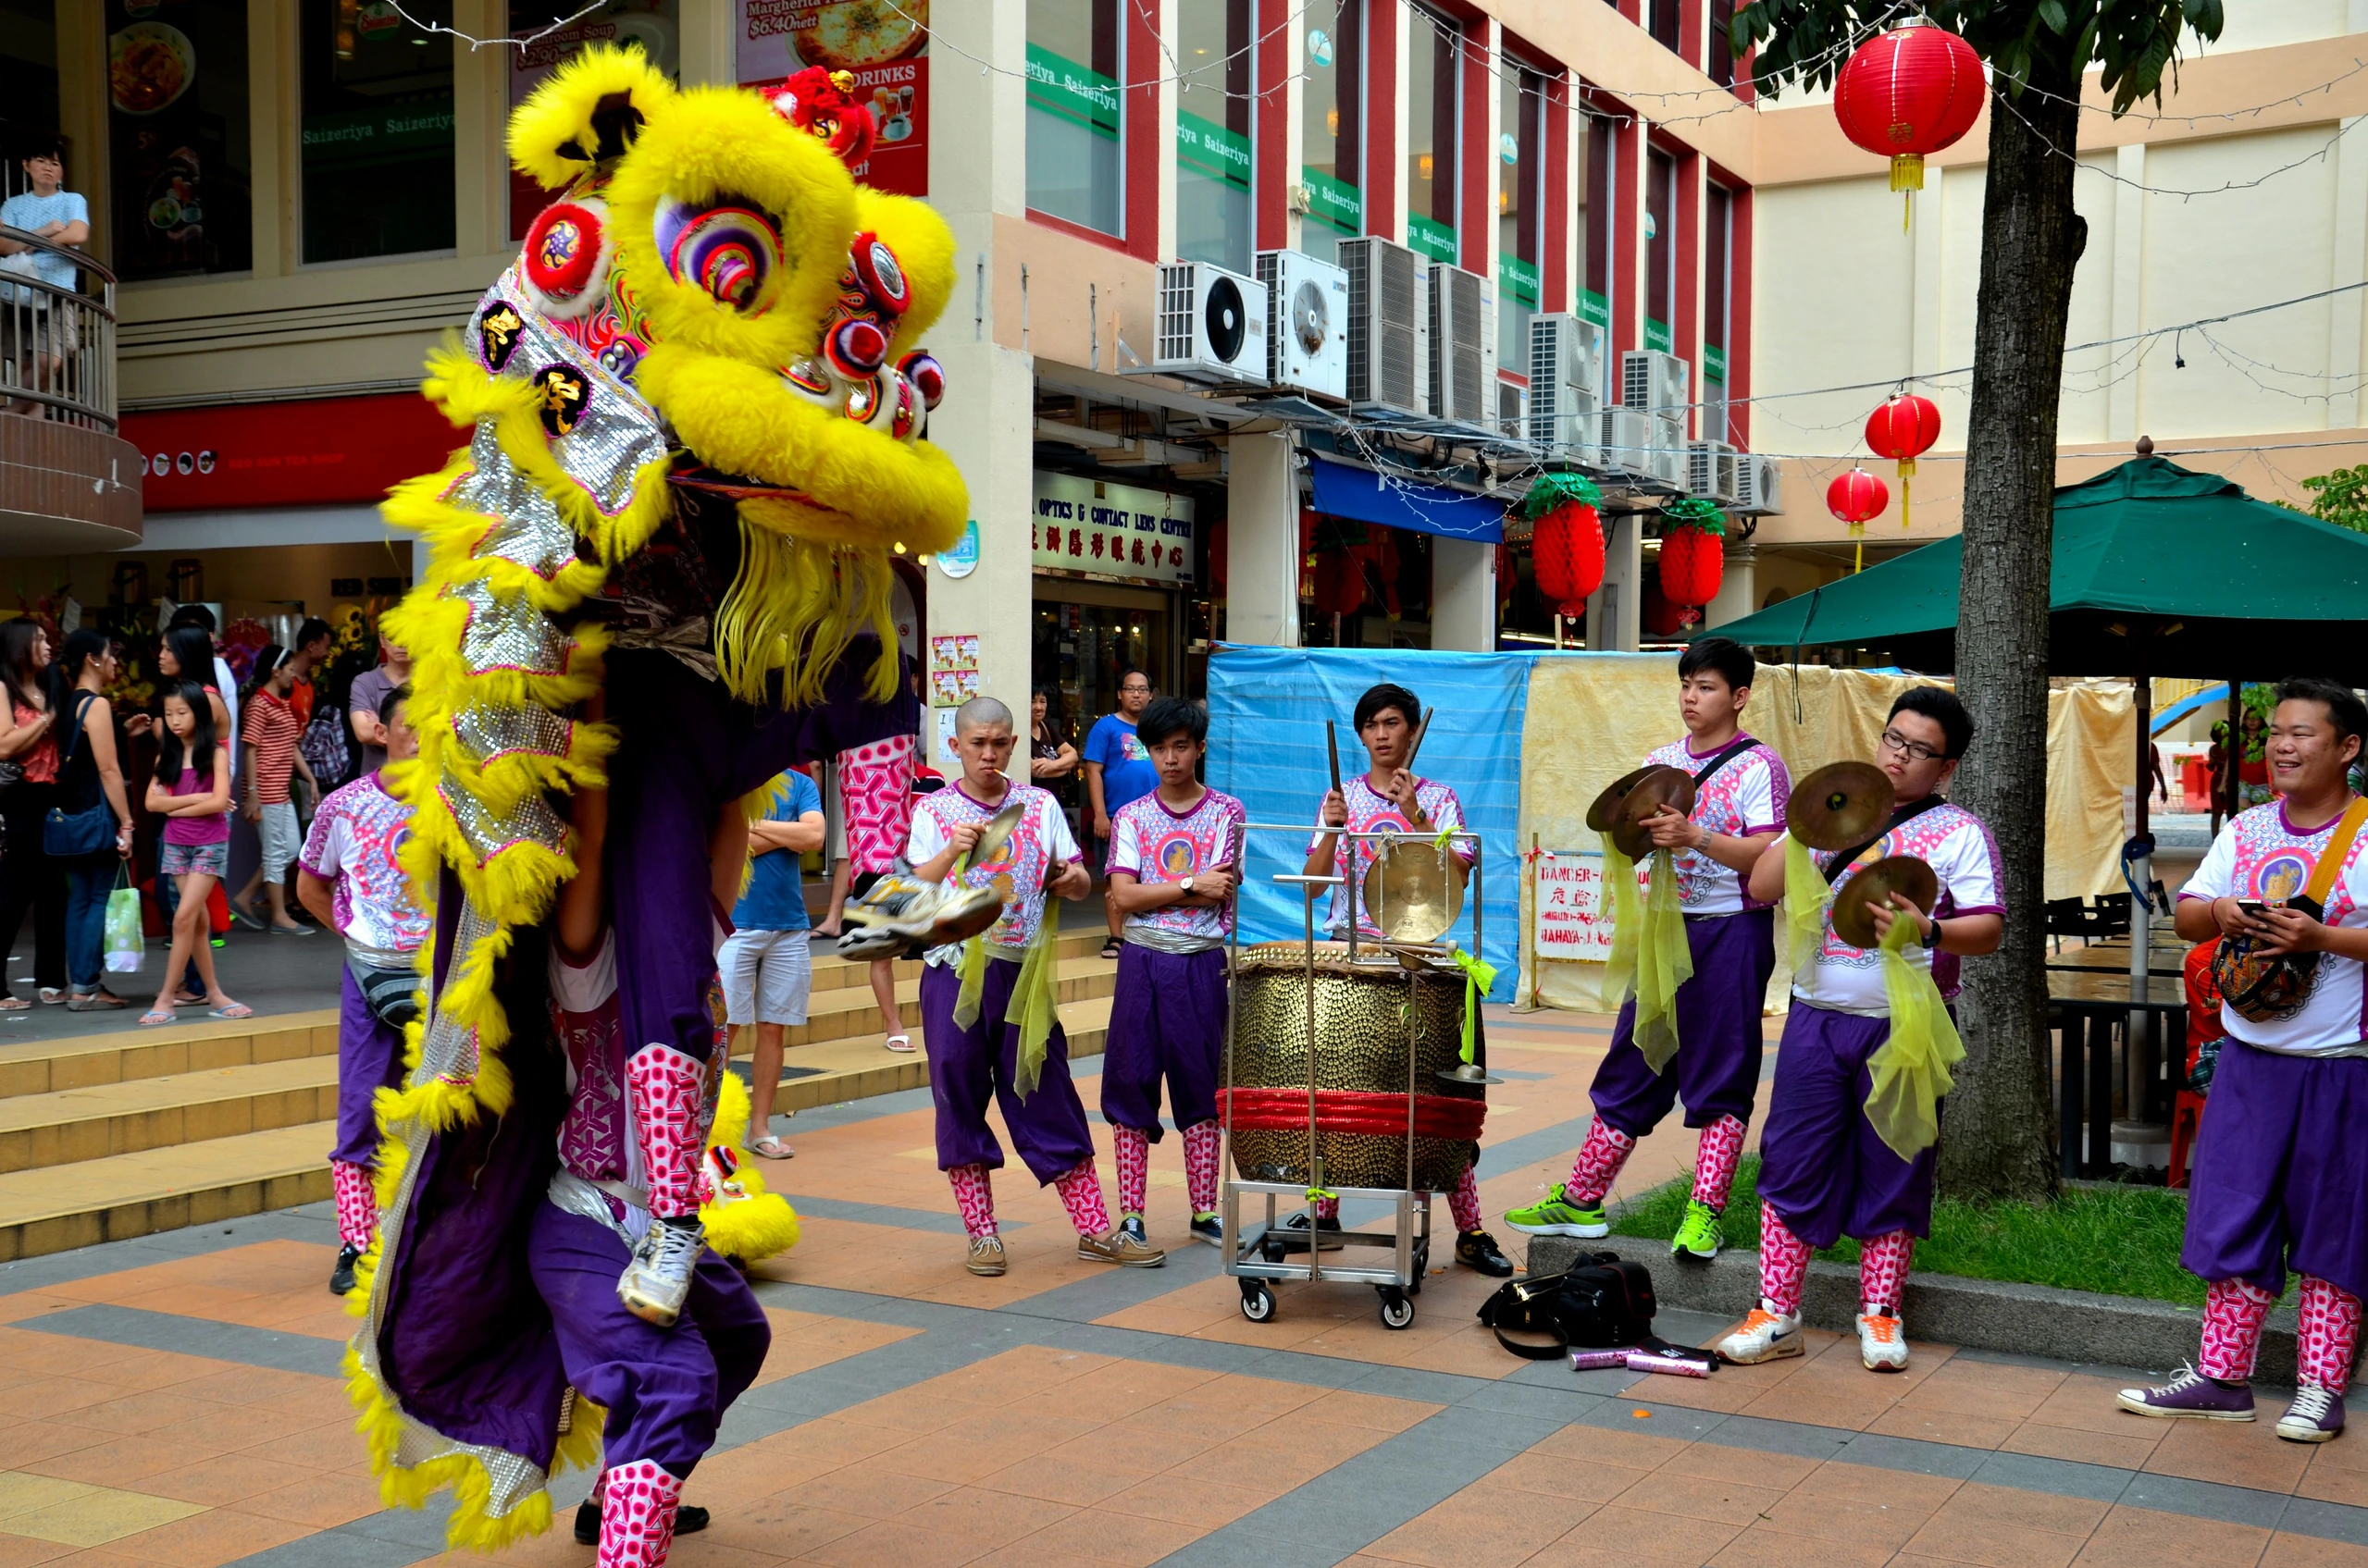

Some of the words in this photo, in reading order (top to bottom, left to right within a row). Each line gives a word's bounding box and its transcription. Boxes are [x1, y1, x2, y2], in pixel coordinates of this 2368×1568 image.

[584, 25, 615, 39] Soup
[302, 123, 375, 144] Saizeriya
[1204, 133, 1250, 166] Saizeriya
[1321, 186, 1360, 214] Saizeriya
[1422, 228, 1456, 253] Saizeriya
[1038, 498, 1073, 519] OPTICS
[1090, 506, 1129, 528] CONTACT
[1134, 512, 1156, 533] LENS
[1159, 517, 1192, 538] CENTRE
